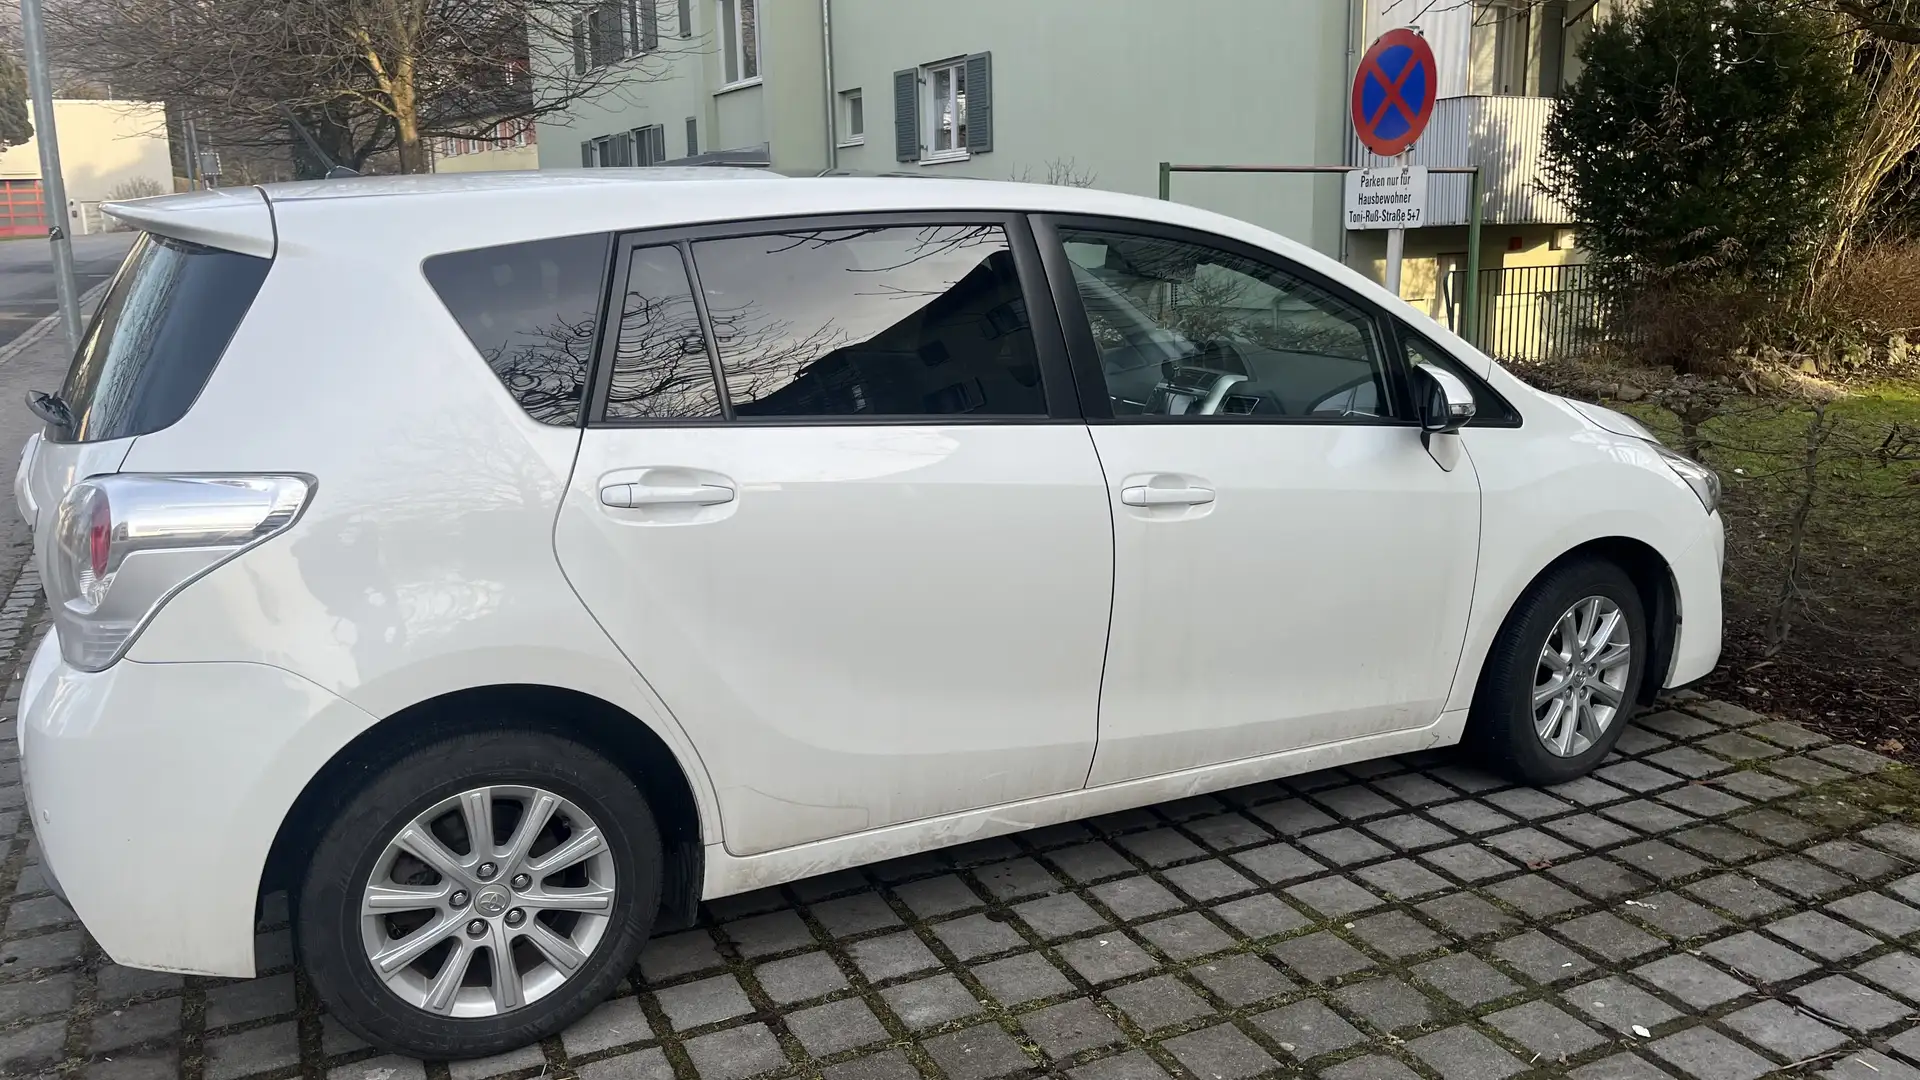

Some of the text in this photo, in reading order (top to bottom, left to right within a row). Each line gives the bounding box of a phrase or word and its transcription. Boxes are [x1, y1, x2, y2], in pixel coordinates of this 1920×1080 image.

[1360, 175, 1385, 188] Parken
[1386, 176, 1399, 187] nur
[1358, 191, 1412, 205] Hausbewohner
[1349, 208, 1420, 223] Toni-Ruß-Straße 5+7
